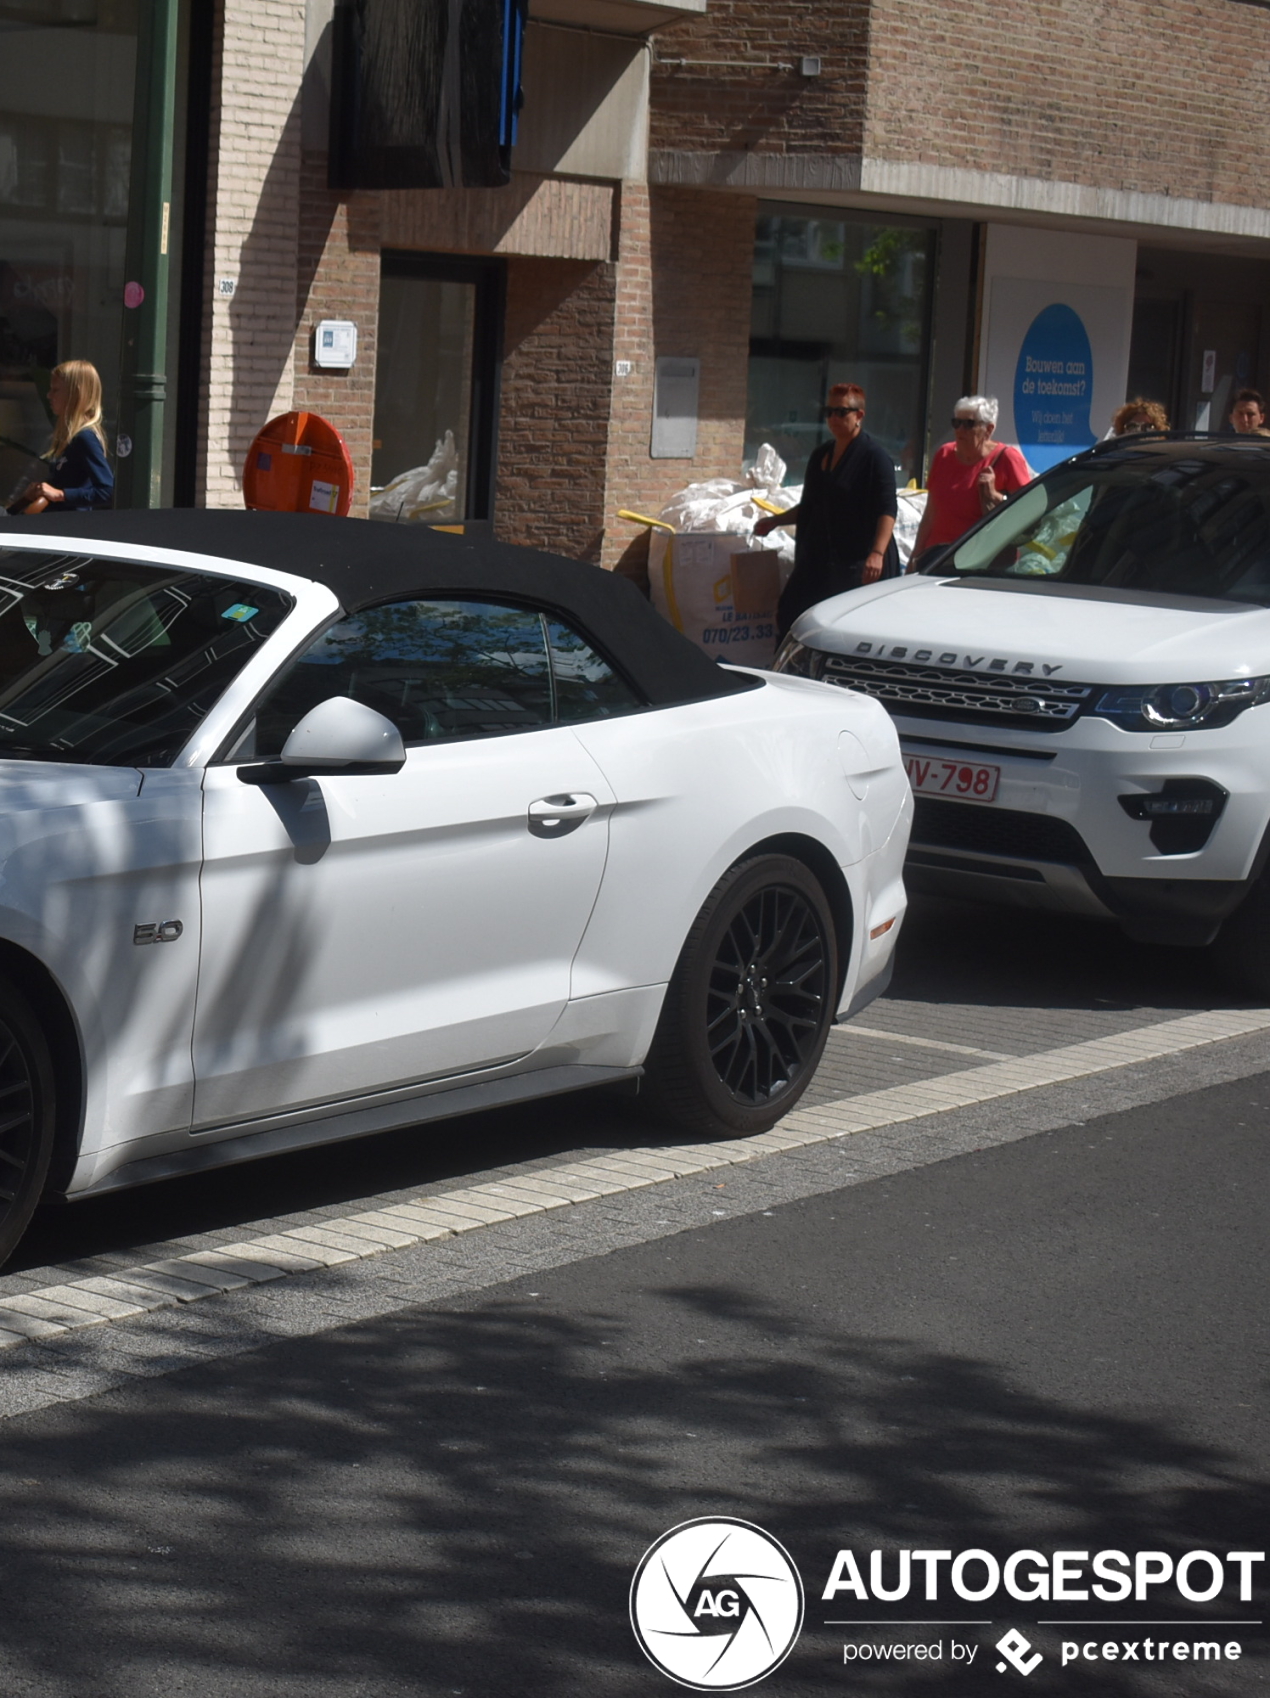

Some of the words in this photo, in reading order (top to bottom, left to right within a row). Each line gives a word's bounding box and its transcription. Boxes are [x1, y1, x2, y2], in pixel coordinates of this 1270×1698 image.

[220, 280, 234, 294] 308
[1026, 357, 1064, 374] Bouwen
[1066, 361, 1085, 375] aan
[1022, 378, 1035, 394] de
[1037, 379, 1086, 396] toekomst?
[855, 641, 1063, 677] DISCOVERY
[133, 919, 183, 946] 5.0
